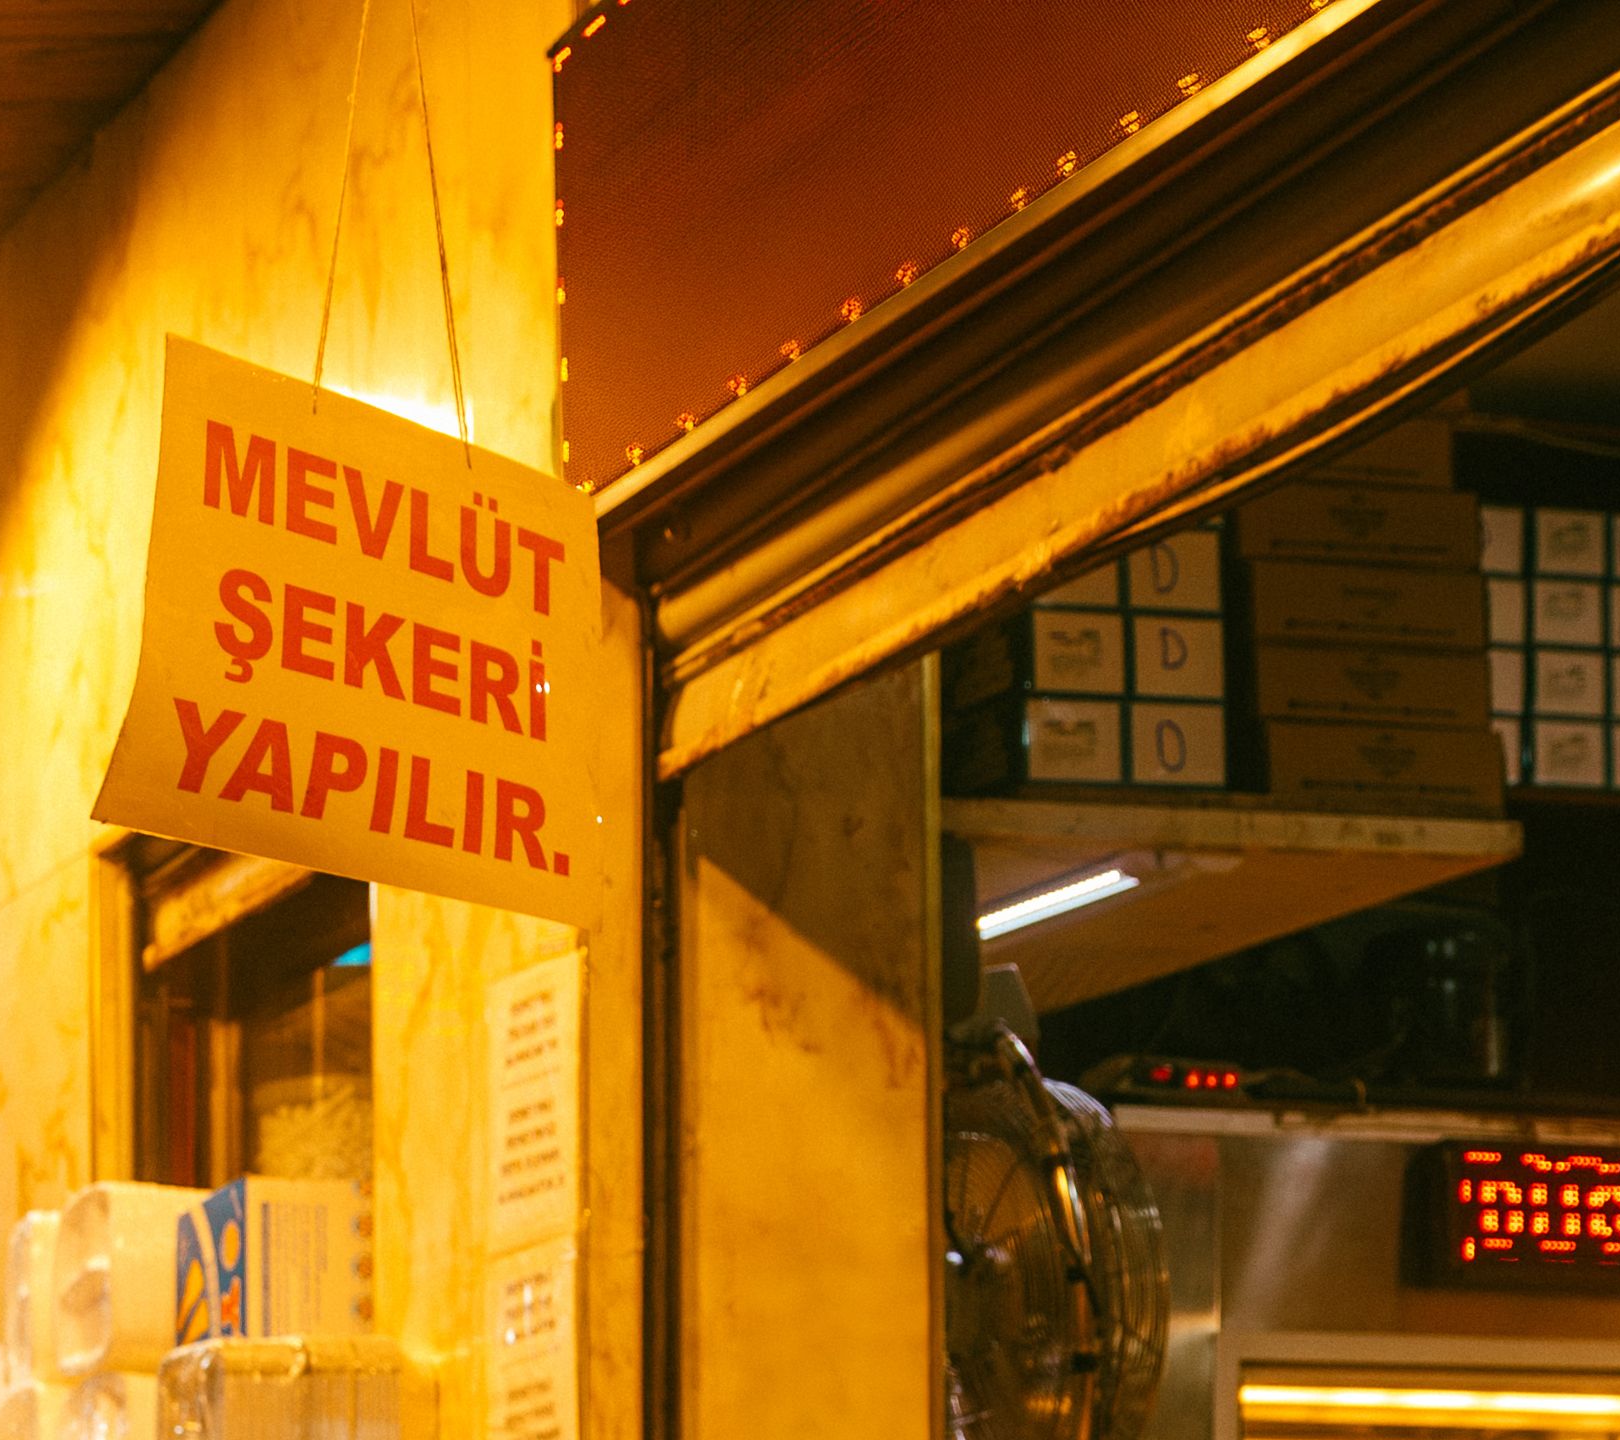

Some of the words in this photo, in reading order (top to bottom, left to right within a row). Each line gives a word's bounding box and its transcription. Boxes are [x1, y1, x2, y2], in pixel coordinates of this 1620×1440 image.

[203, 419, 565, 617] MEVLÜT
[213, 568, 548, 742] ŞEKERİ
[173, 697, 570, 877] YAPILIR.
